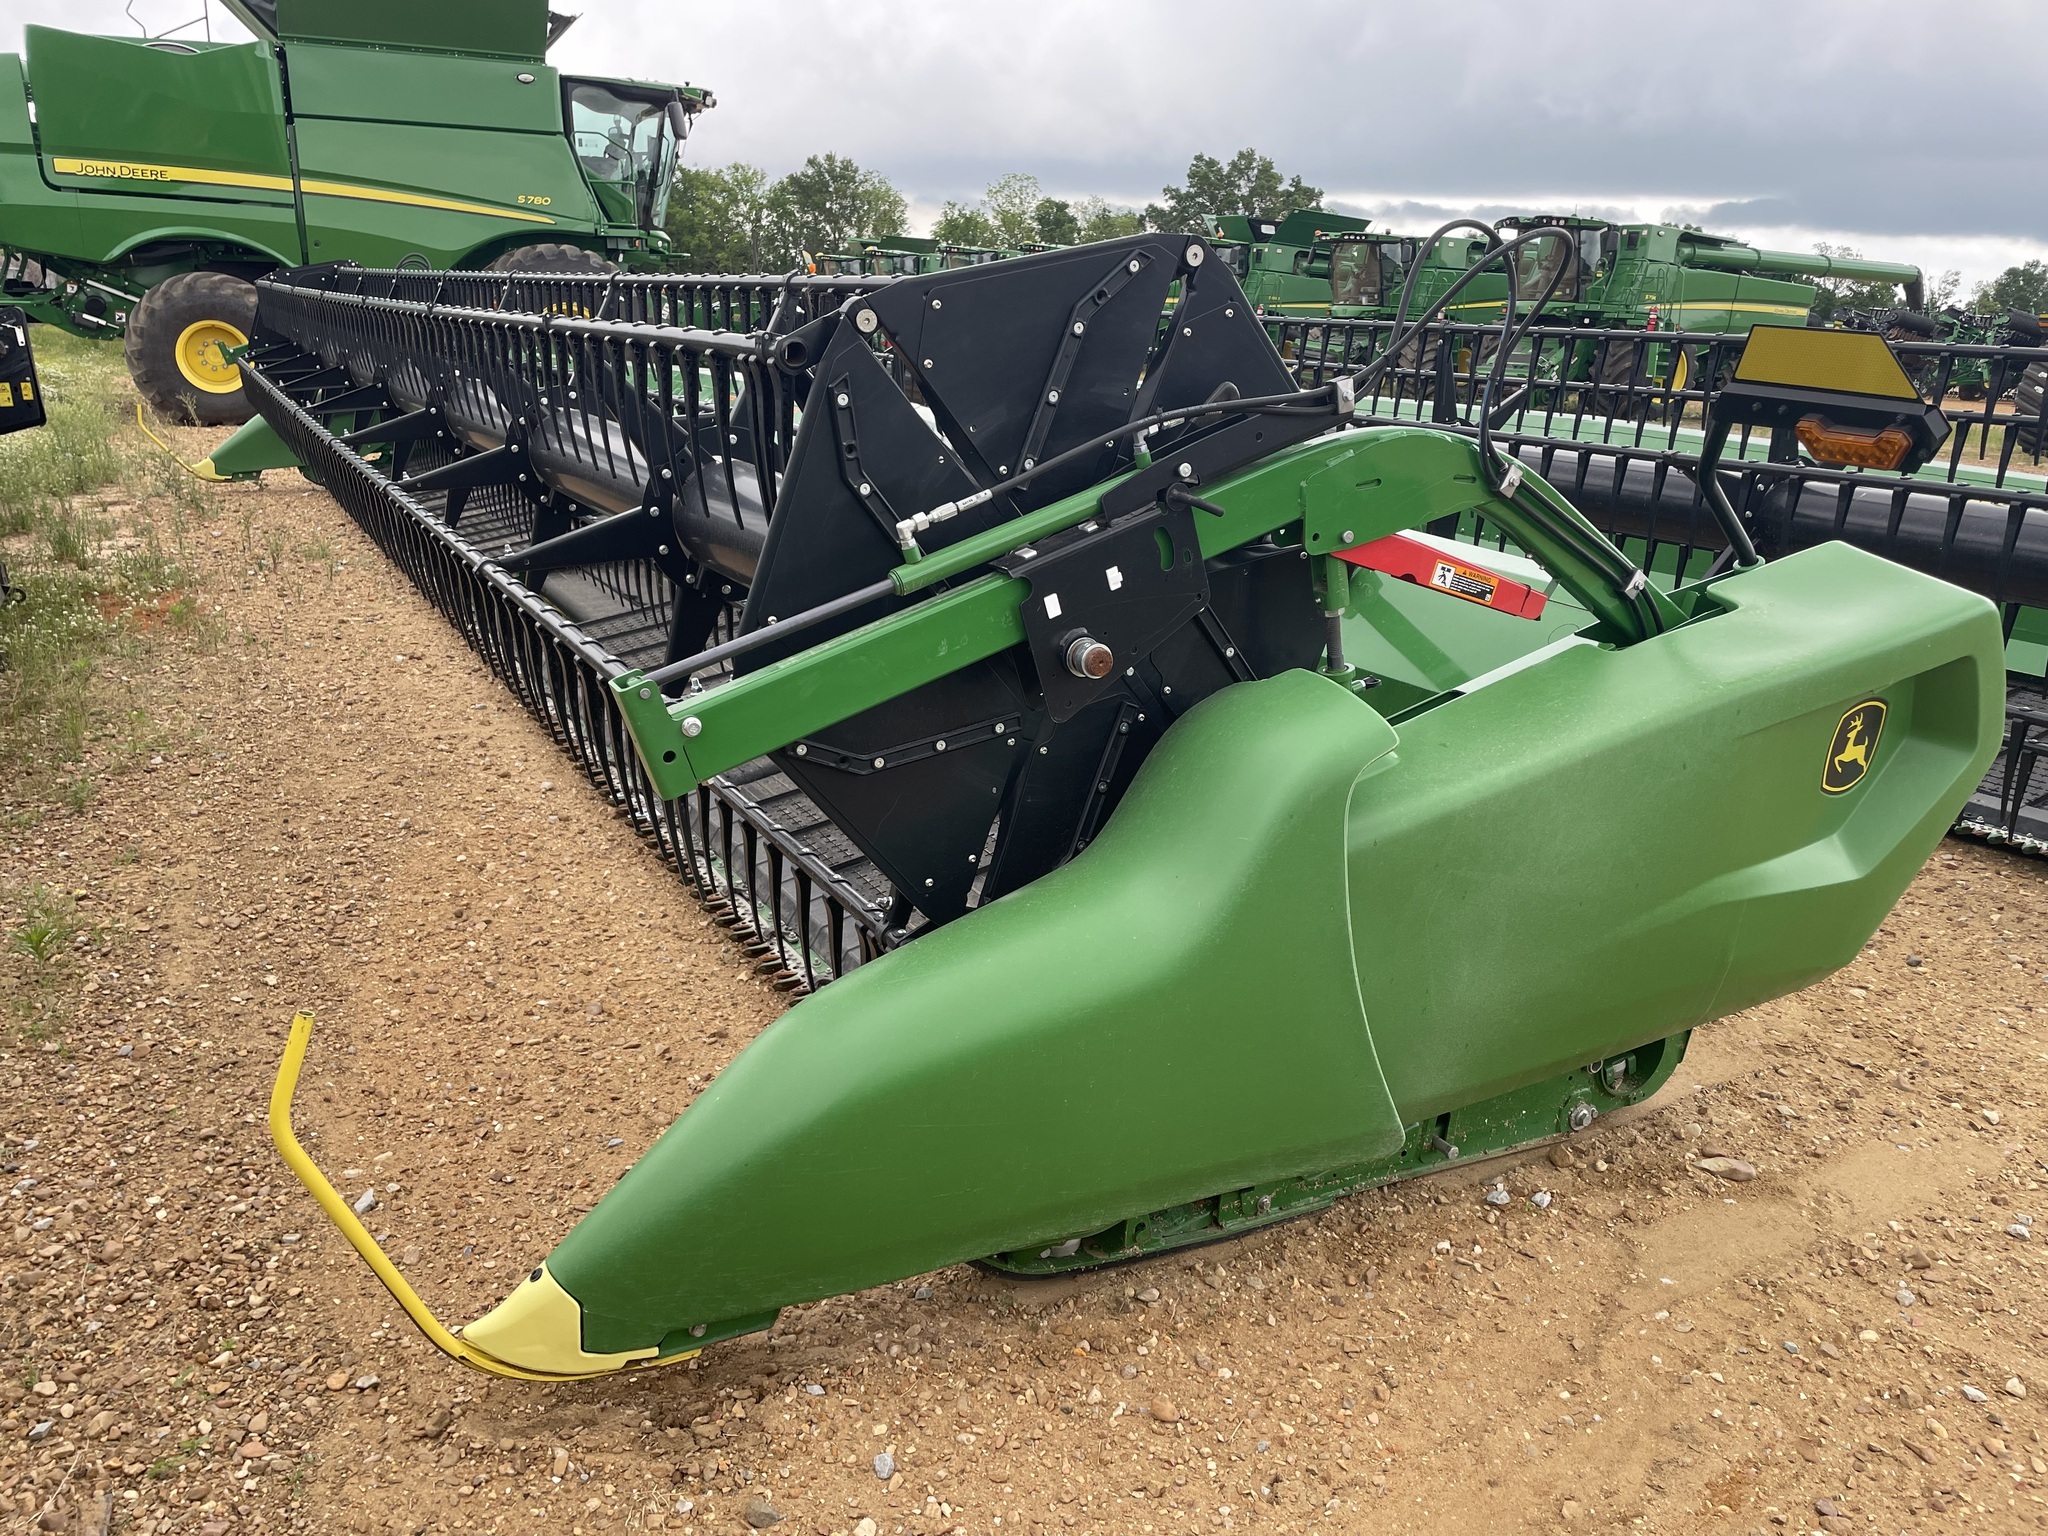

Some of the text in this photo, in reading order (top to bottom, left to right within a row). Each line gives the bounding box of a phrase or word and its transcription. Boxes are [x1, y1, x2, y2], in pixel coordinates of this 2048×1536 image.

[76, 162, 169, 179] JOHN DEERE
[1468, 571, 1492, 584] WARNING
